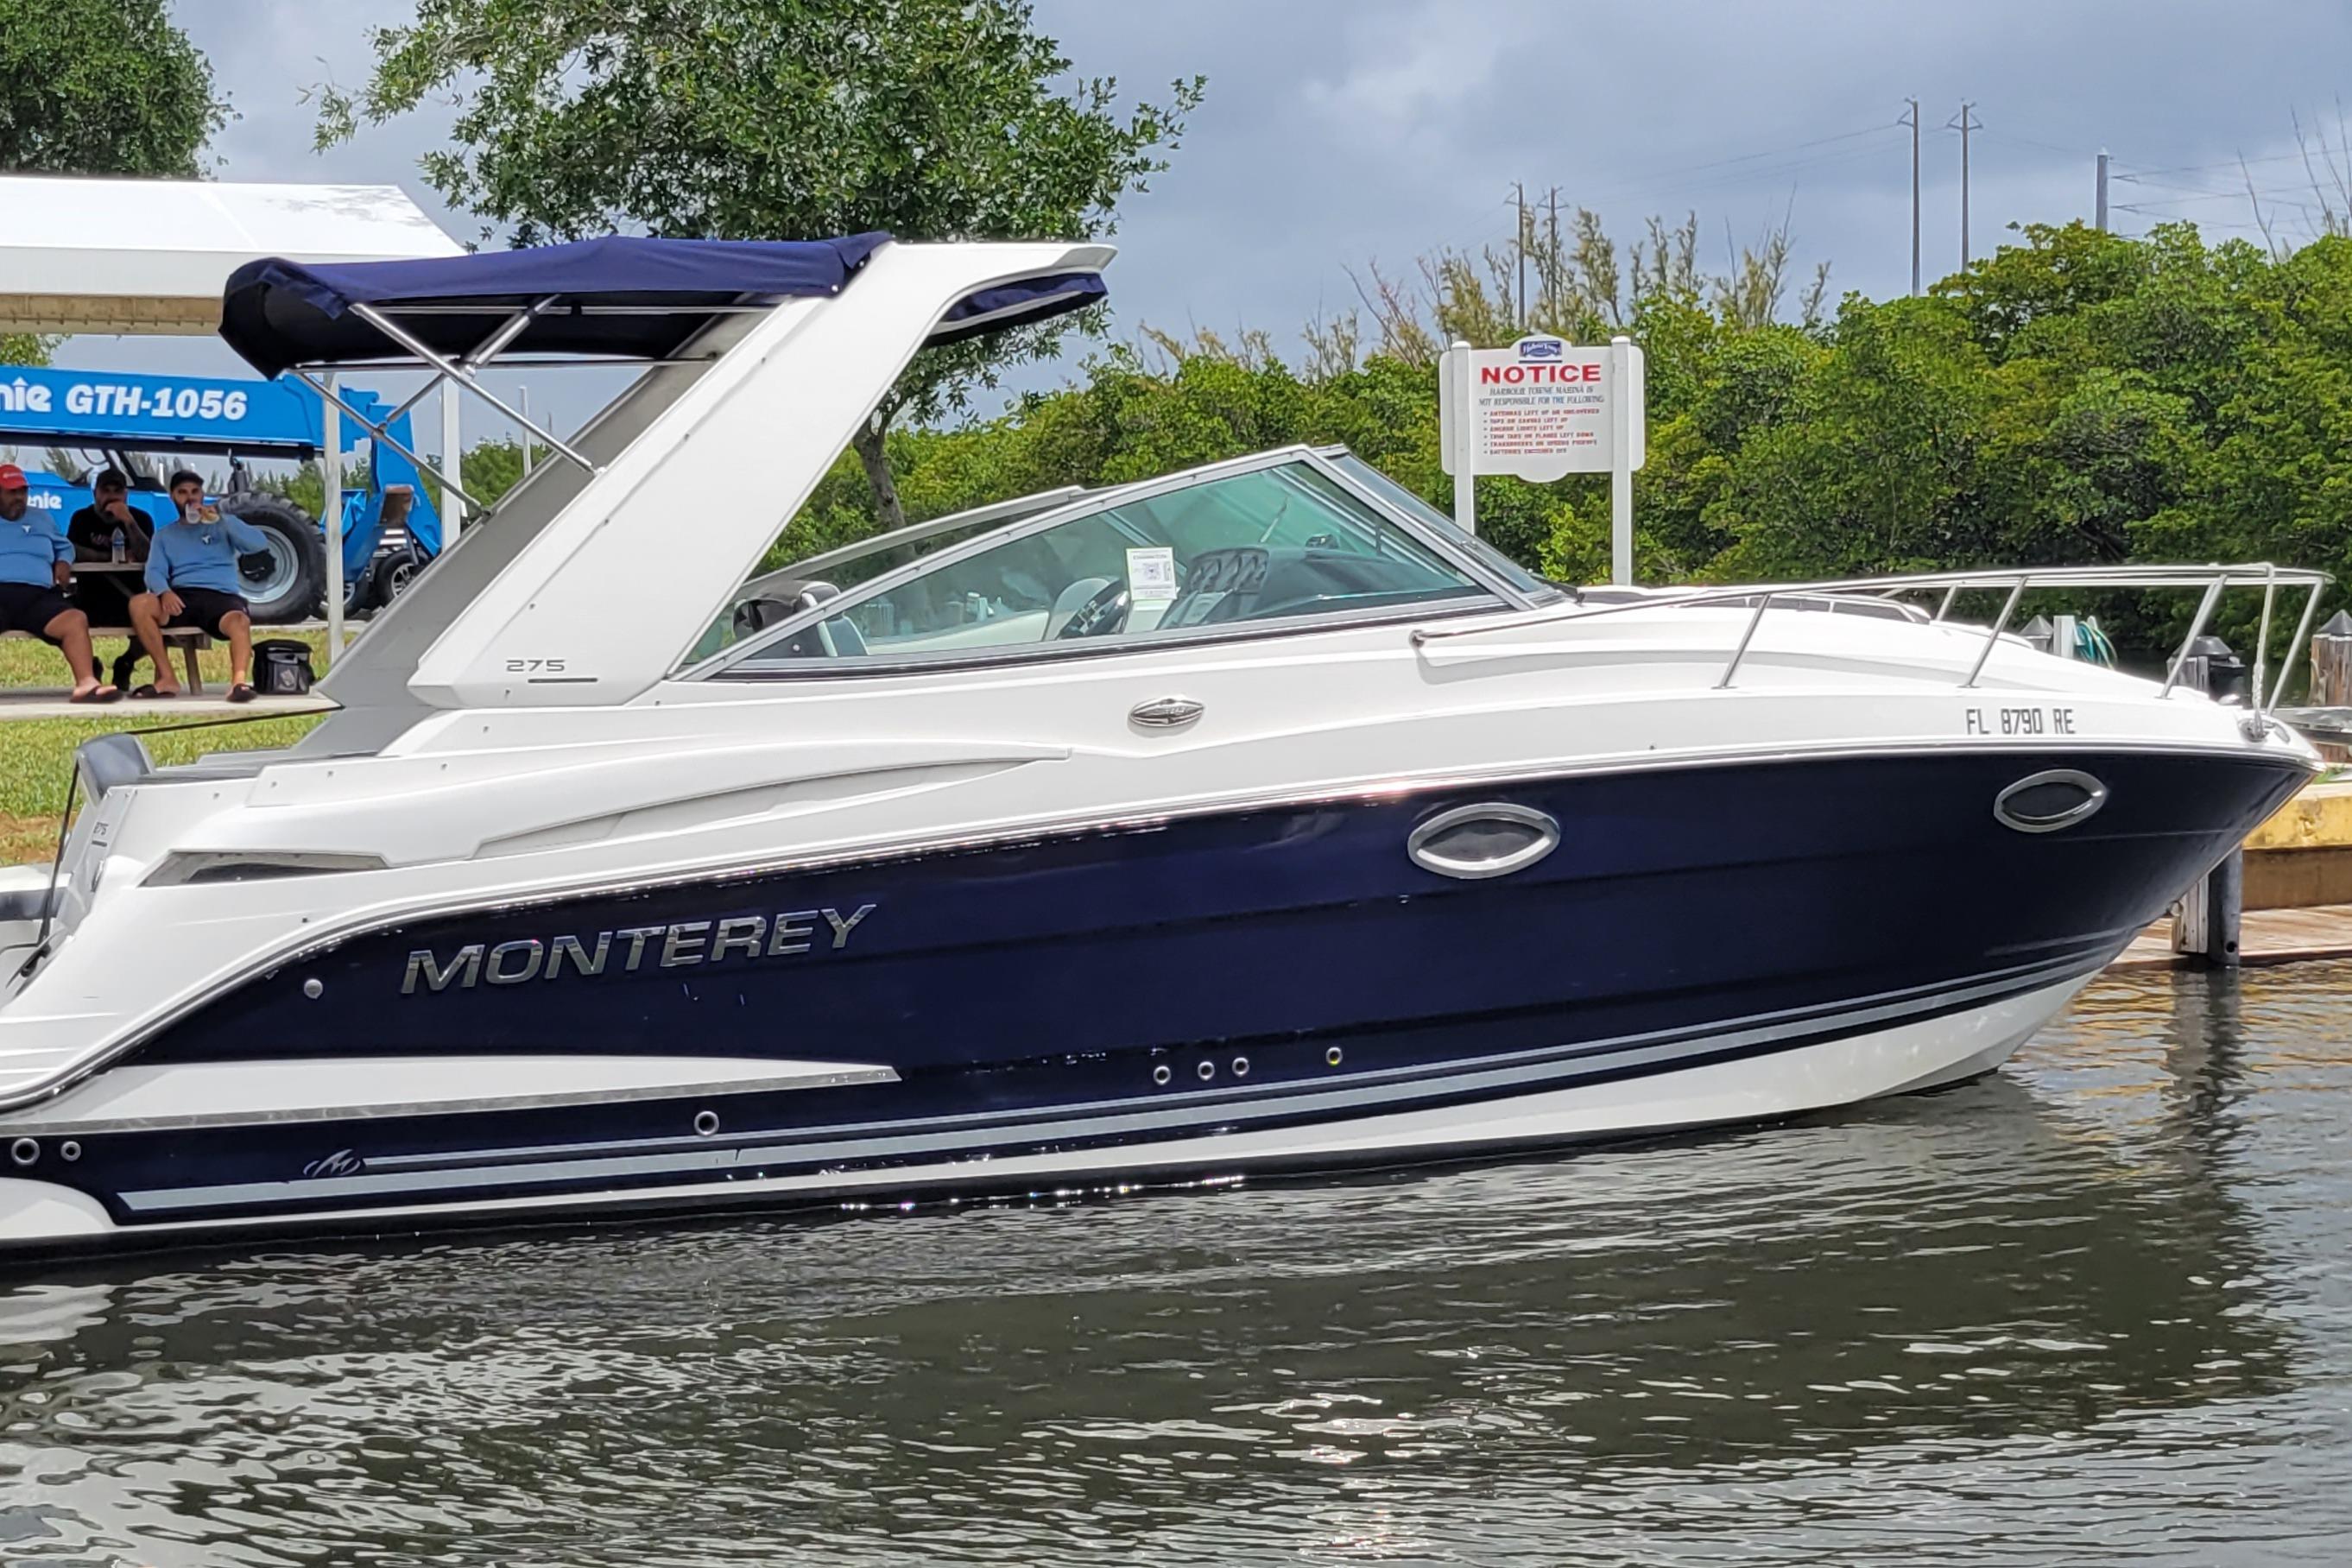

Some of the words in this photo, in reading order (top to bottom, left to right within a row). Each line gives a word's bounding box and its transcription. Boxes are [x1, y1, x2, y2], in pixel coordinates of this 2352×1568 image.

[1481, 364, 1602, 385] NOTICE
[66, 384, 248, 420] GTH-1056
[506, 659, 566, 673] 275
[1965, 708, 1990, 735] FL
[2000, 707, 2044, 735] 8790
[2052, 708, 2077, 735] RE
[401, 903, 877, 995] MONTEREY
